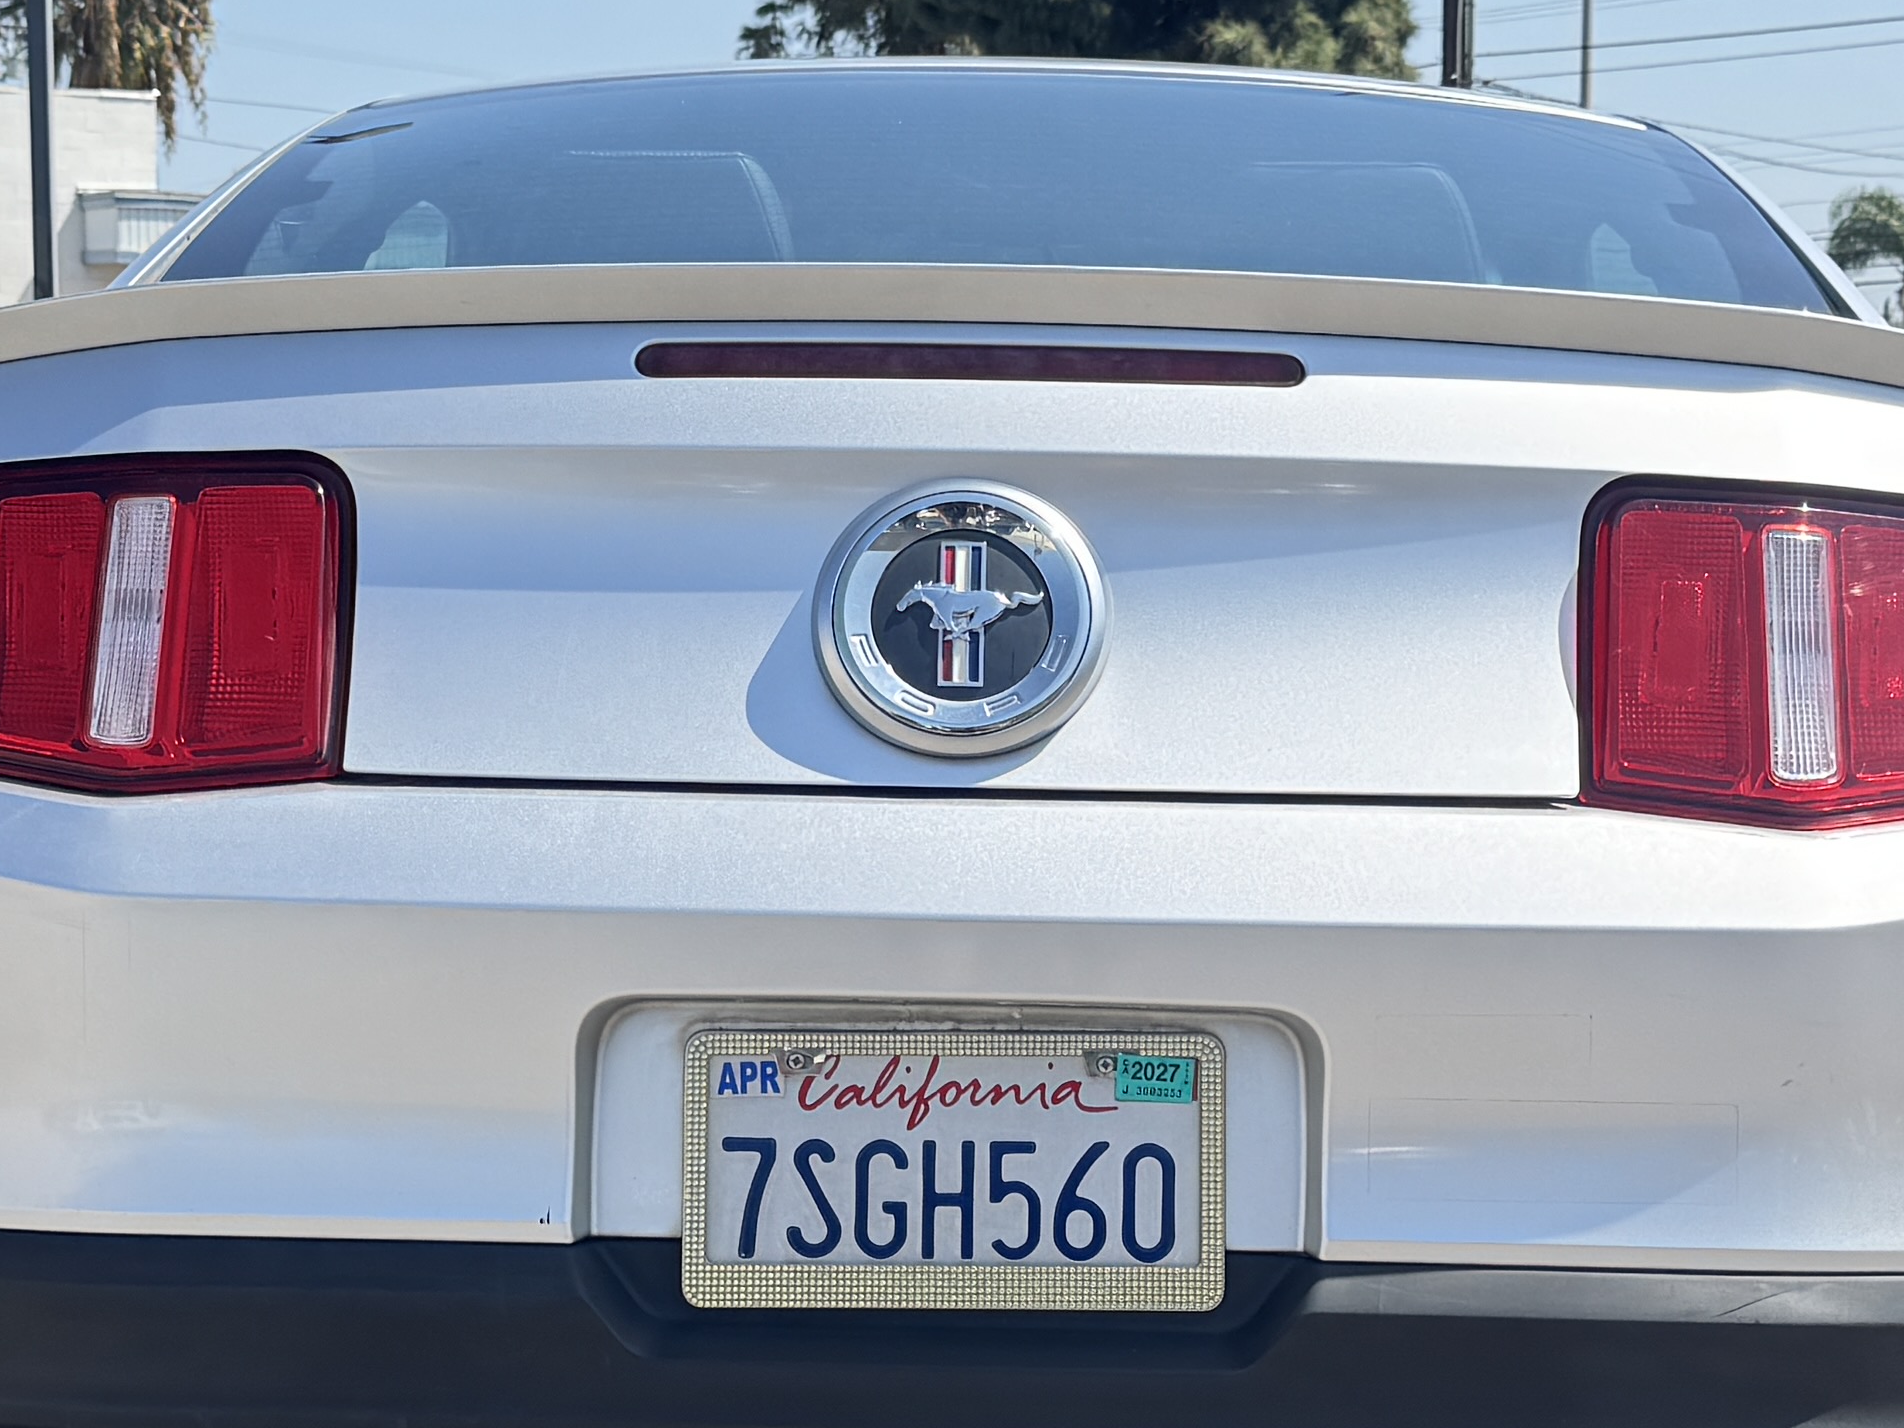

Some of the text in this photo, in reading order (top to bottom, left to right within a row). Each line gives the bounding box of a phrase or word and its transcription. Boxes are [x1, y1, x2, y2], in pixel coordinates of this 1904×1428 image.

[717, 1060, 781, 1096] APR
[798, 1054, 1119, 1131] California
[1130, 1060, 1181, 1083] 2027
[721, 1137, 1176, 1264] 7SGH560
